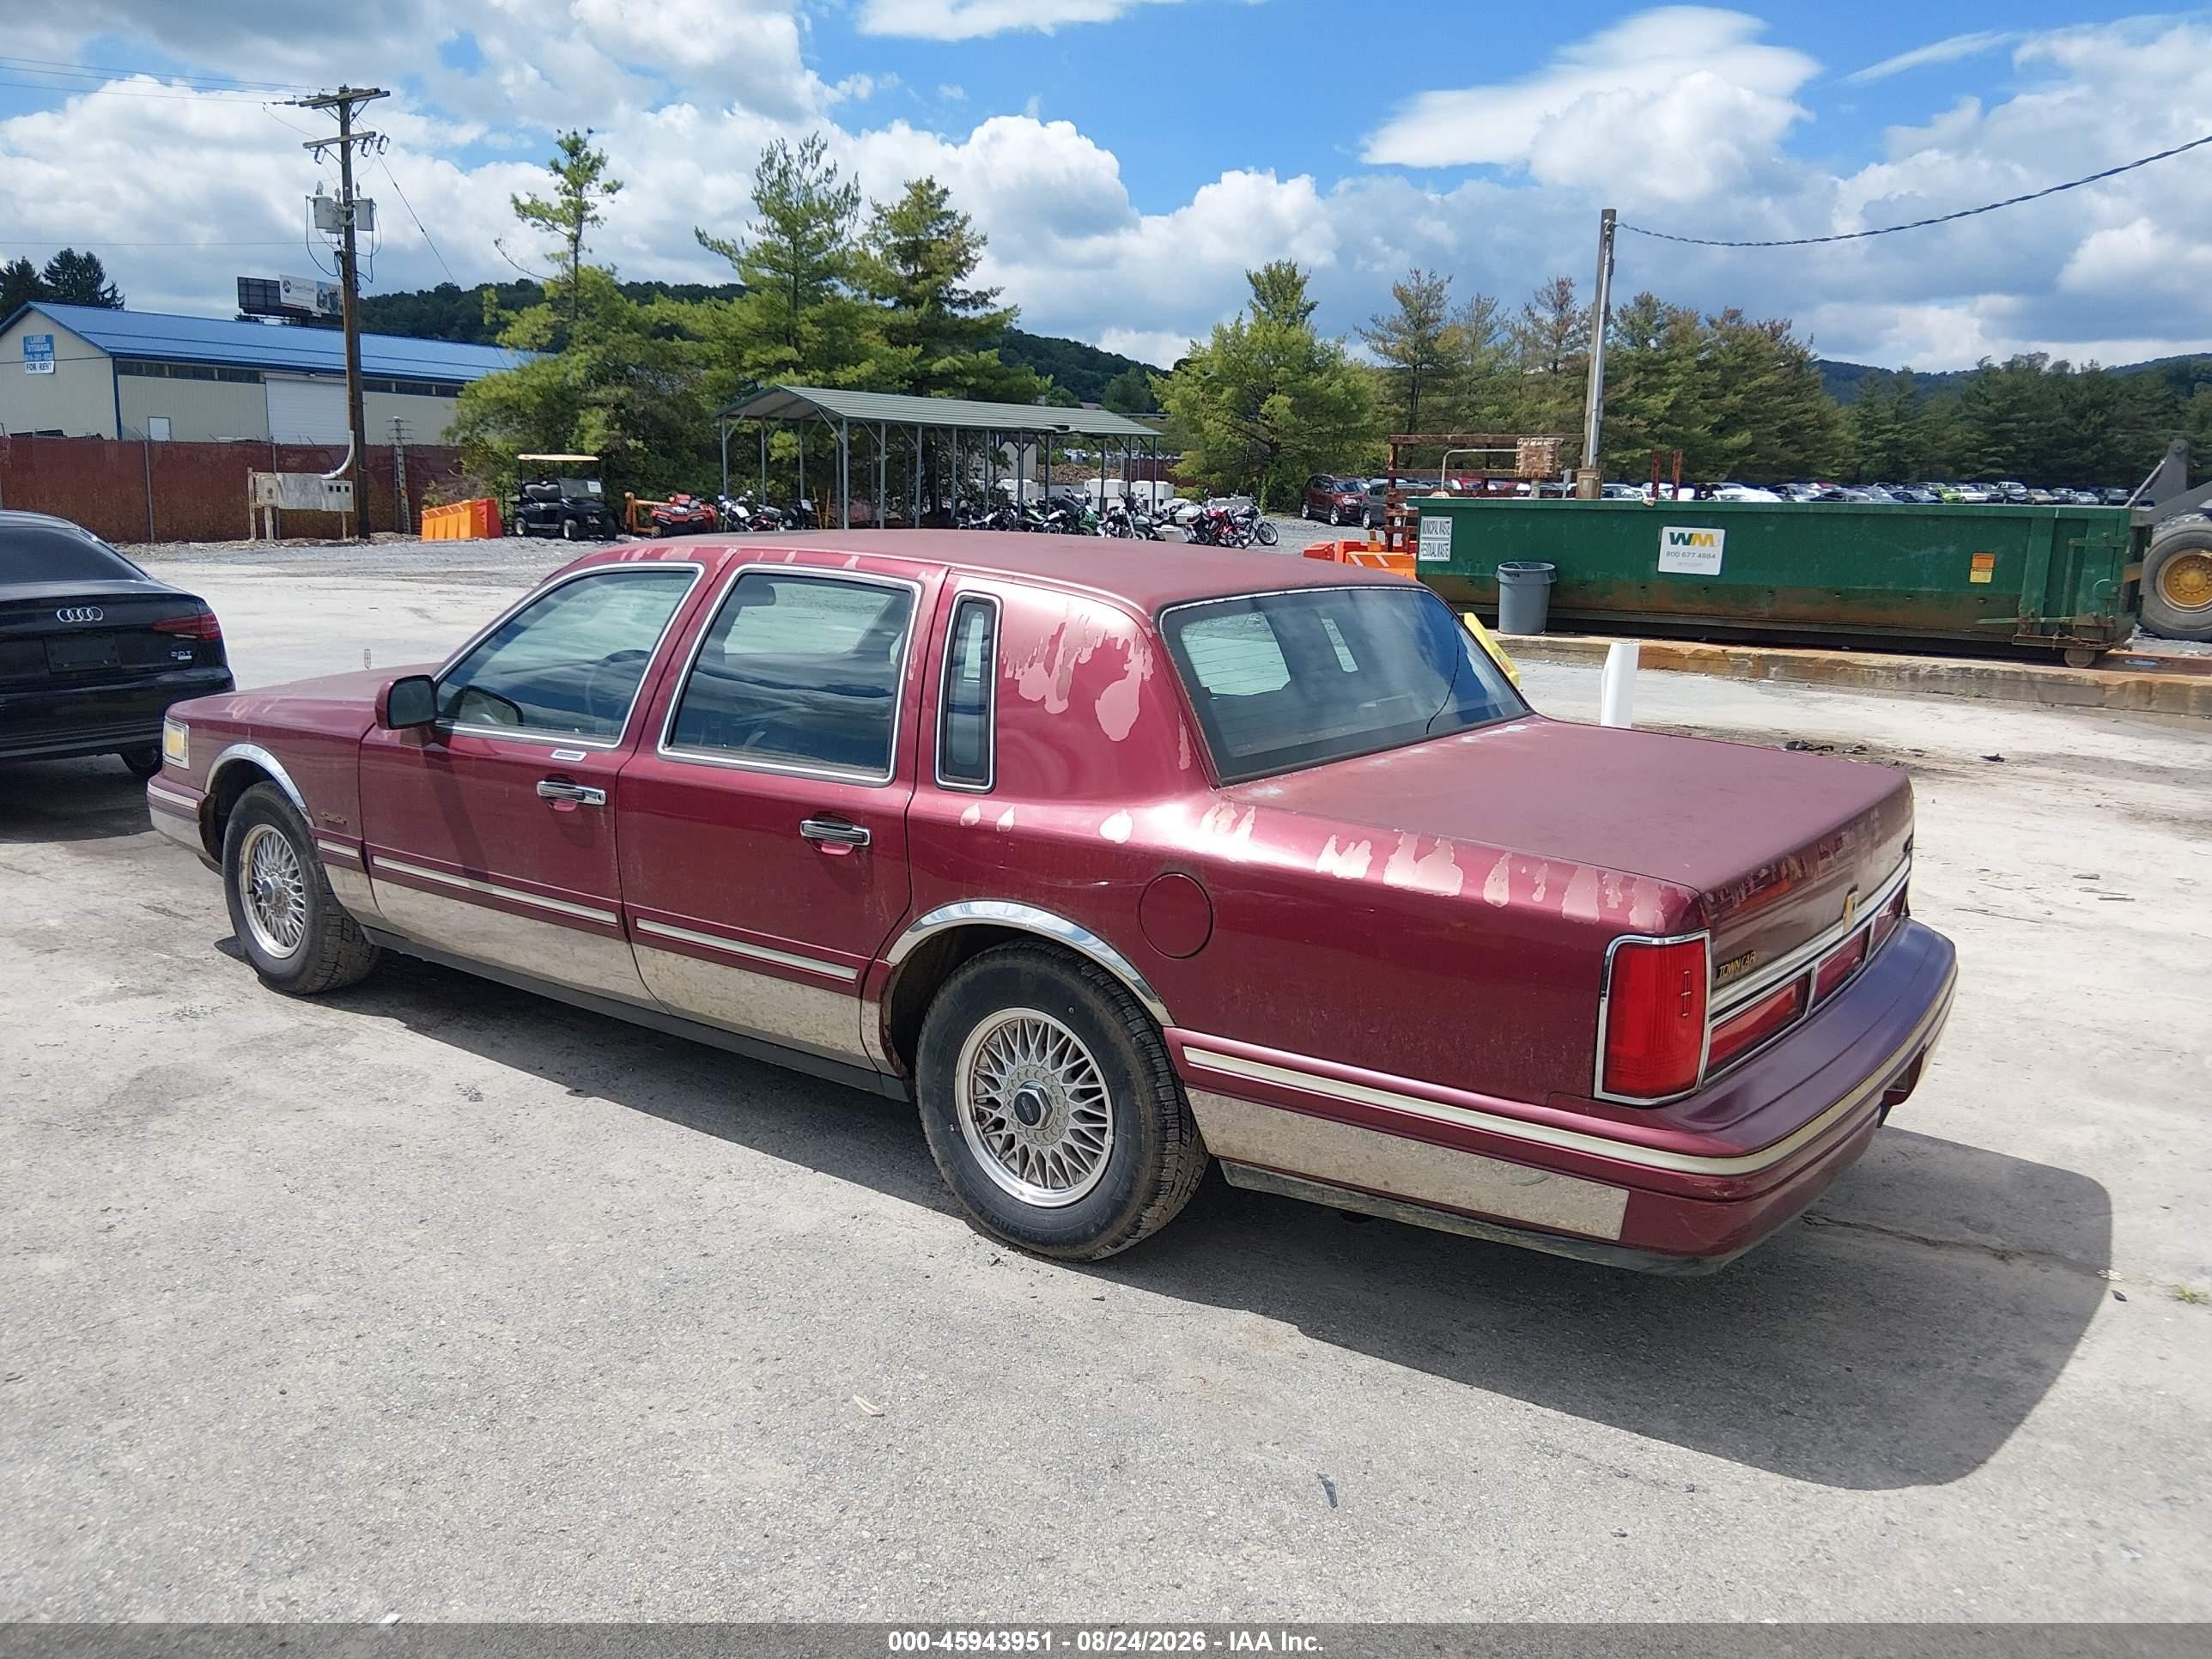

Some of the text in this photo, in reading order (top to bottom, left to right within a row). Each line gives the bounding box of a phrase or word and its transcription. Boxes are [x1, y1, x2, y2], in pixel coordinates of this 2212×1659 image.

[1669, 532, 1716, 547] WM
[1719, 951, 1758, 977] TOWN CAR
